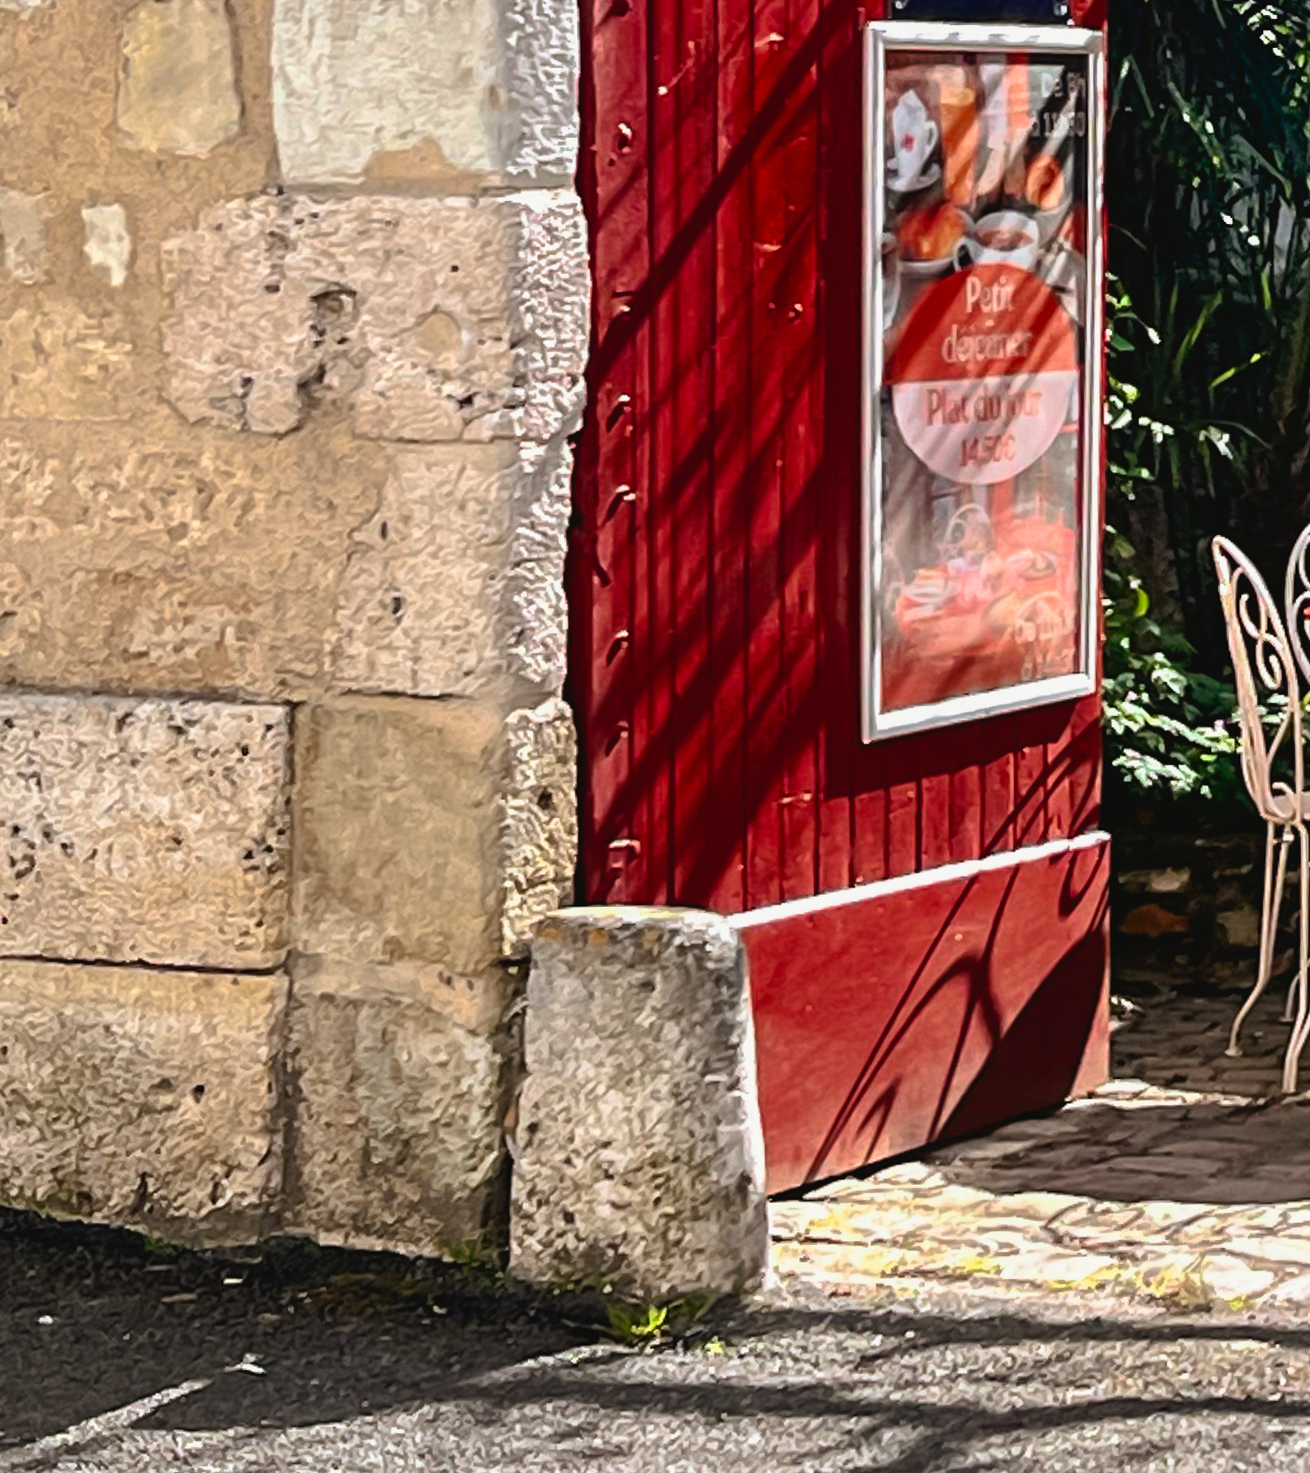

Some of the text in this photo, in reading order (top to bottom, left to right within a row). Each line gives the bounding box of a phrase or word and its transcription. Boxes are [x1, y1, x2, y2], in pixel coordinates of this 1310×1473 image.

[965, 275, 1016, 314] Petit
[940, 318, 1034, 372] déjeuner
[925, 386, 968, 427] Plat
[973, 382, 1000, 422] du
